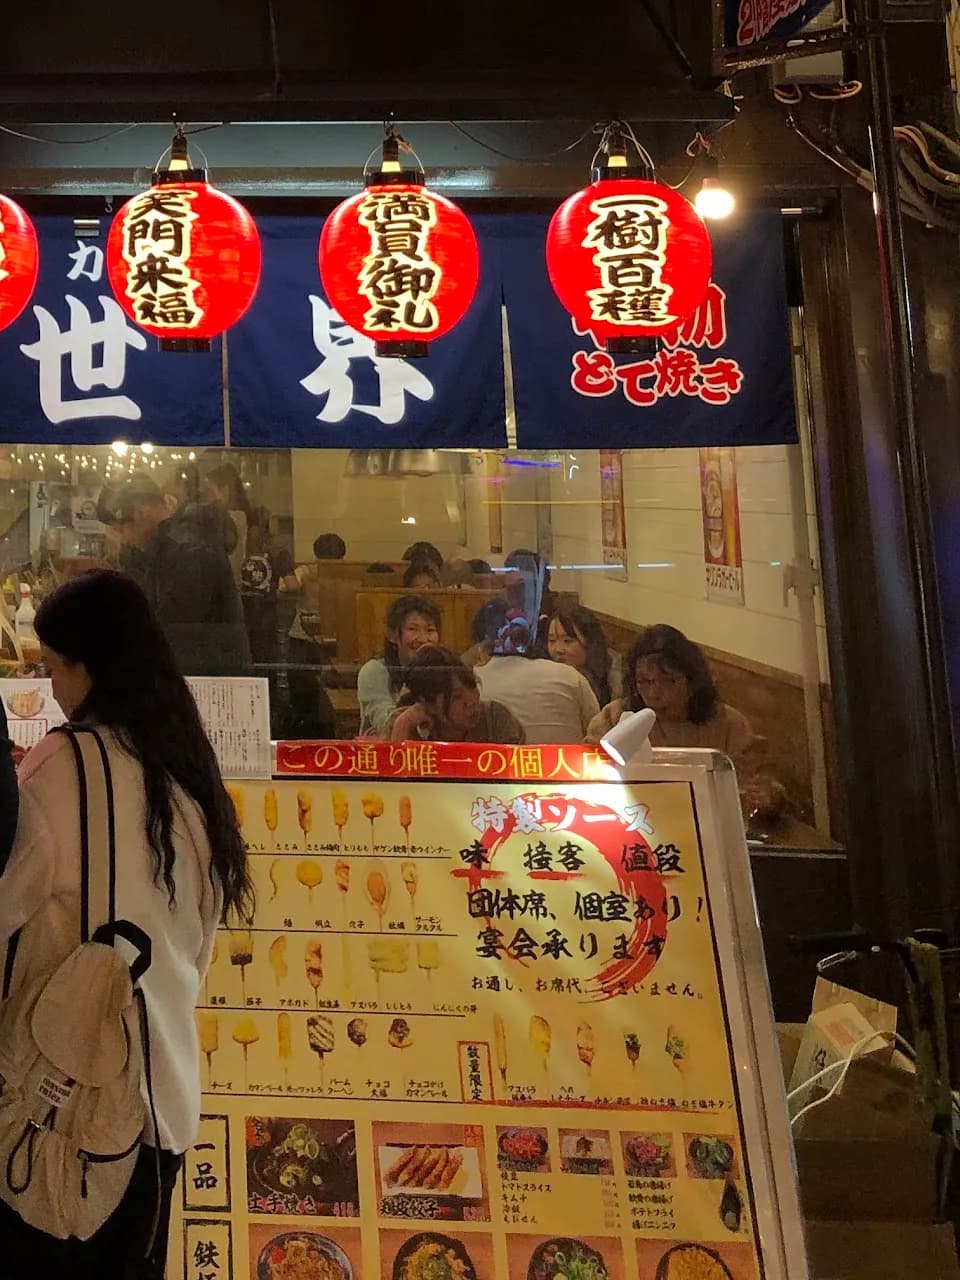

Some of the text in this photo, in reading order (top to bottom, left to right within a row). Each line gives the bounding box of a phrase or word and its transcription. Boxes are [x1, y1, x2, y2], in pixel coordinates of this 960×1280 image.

[127, 191, 197, 326] 笑門来福
[362, 193, 436, 330] 満員御礼
[470, 795, 656, 835] 特製ソース
[459, 840, 687, 874] 味 接客 値段
[475, 926, 667, 962] 宴会承ります
[466, 1045, 484, 1102] 数量限定
[192, 1141, 220, 1191] 一品
[192, 1238, 221, 1280] 鉄
